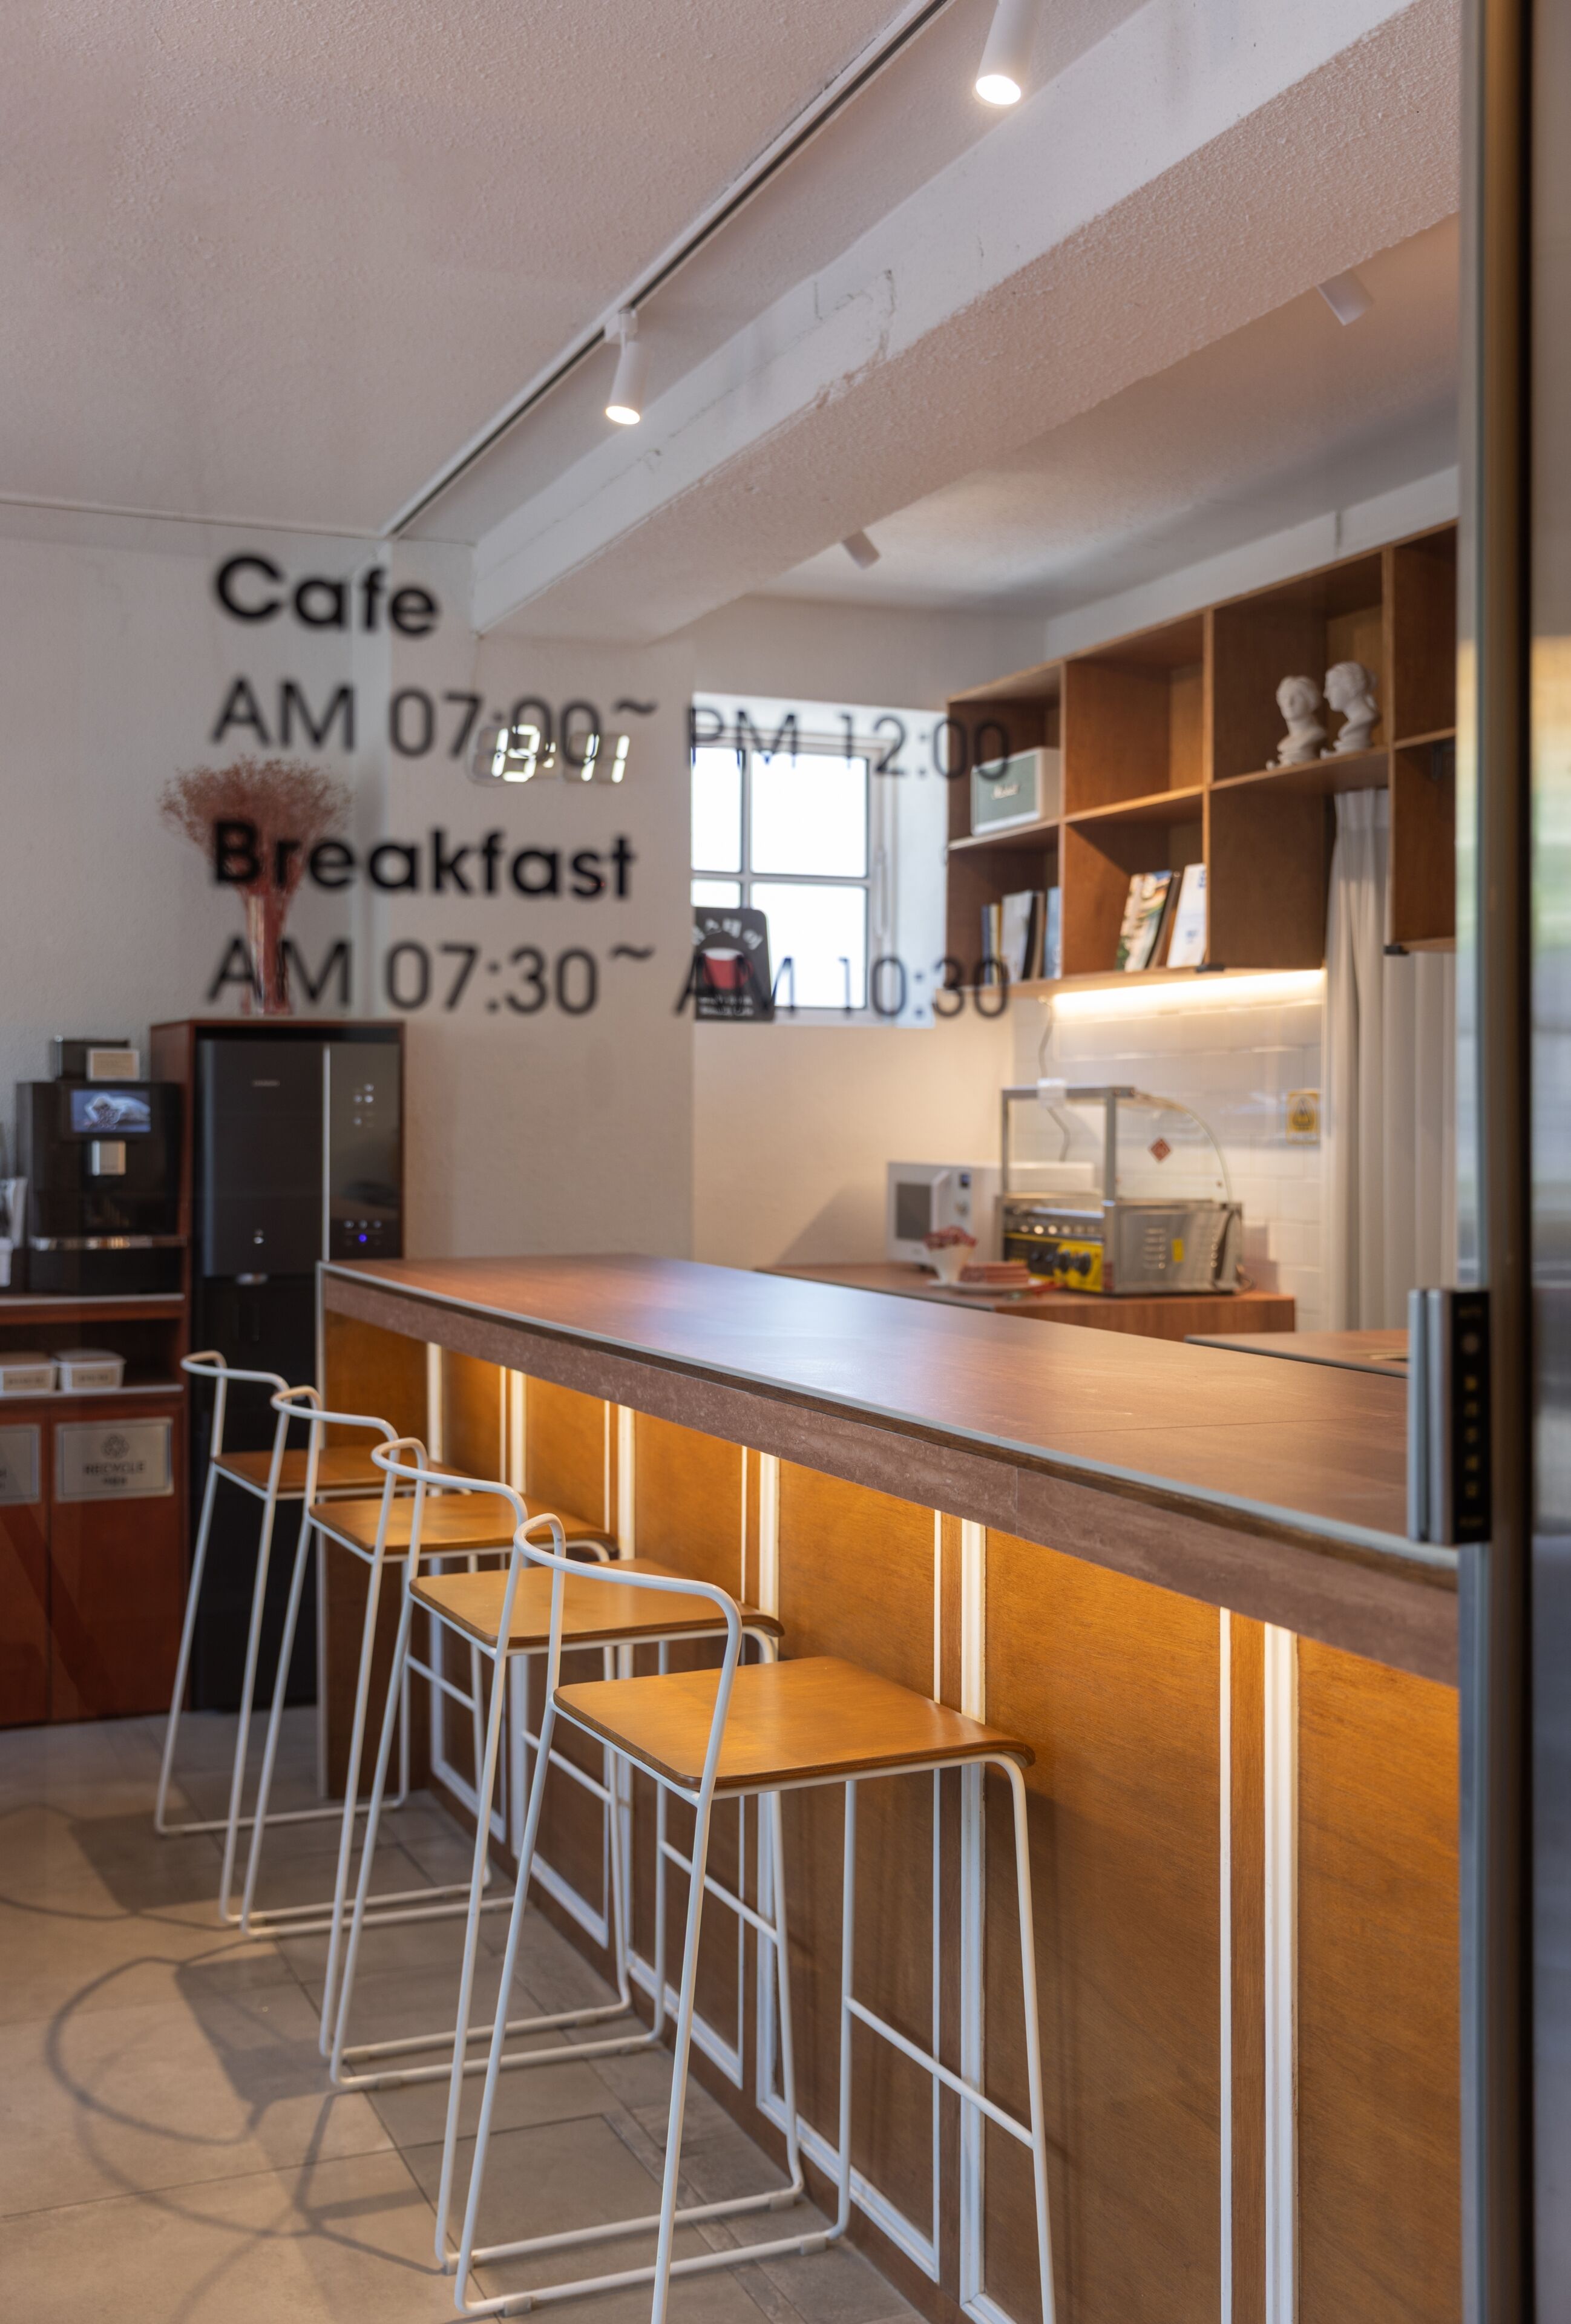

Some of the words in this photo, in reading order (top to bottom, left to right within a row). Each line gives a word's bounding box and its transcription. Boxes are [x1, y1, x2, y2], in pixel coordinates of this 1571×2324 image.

[215, 554, 439, 635] Cafe
[212, 677, 355, 750] AM
[689, 706, 800, 770] PM
[839, 714, 1011, 781] 12:00
[214, 820, 635, 899] Breakfast
[206, 936, 352, 1005] AM
[675, 953, 796, 1020] AM
[838, 956, 1010, 1019] 10:30
